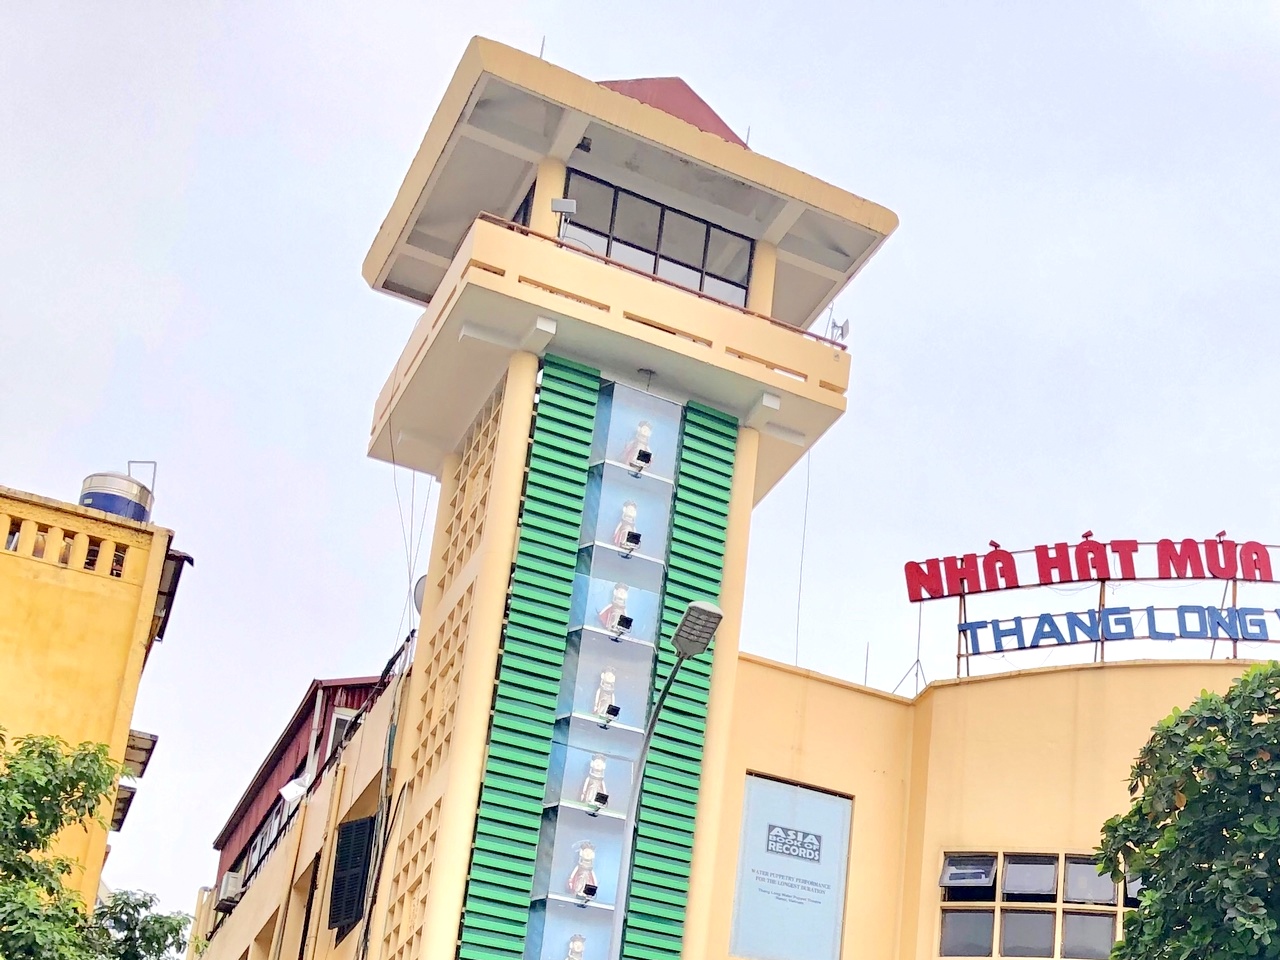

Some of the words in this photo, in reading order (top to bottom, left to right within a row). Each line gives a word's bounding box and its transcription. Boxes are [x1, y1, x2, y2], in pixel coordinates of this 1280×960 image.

[904, 540, 1019, 602] NHÀ
[1035, 531, 1139, 584] HÁT
[1157, 530, 1273, 583] MÚA
[958, 607, 1134, 655] THANG
[1147, 605, 1269, 641] LONG
[769, 827, 820, 845] ASIA
[769, 835, 802, 846] BOOK
[768, 841, 819, 860] RECORDS
